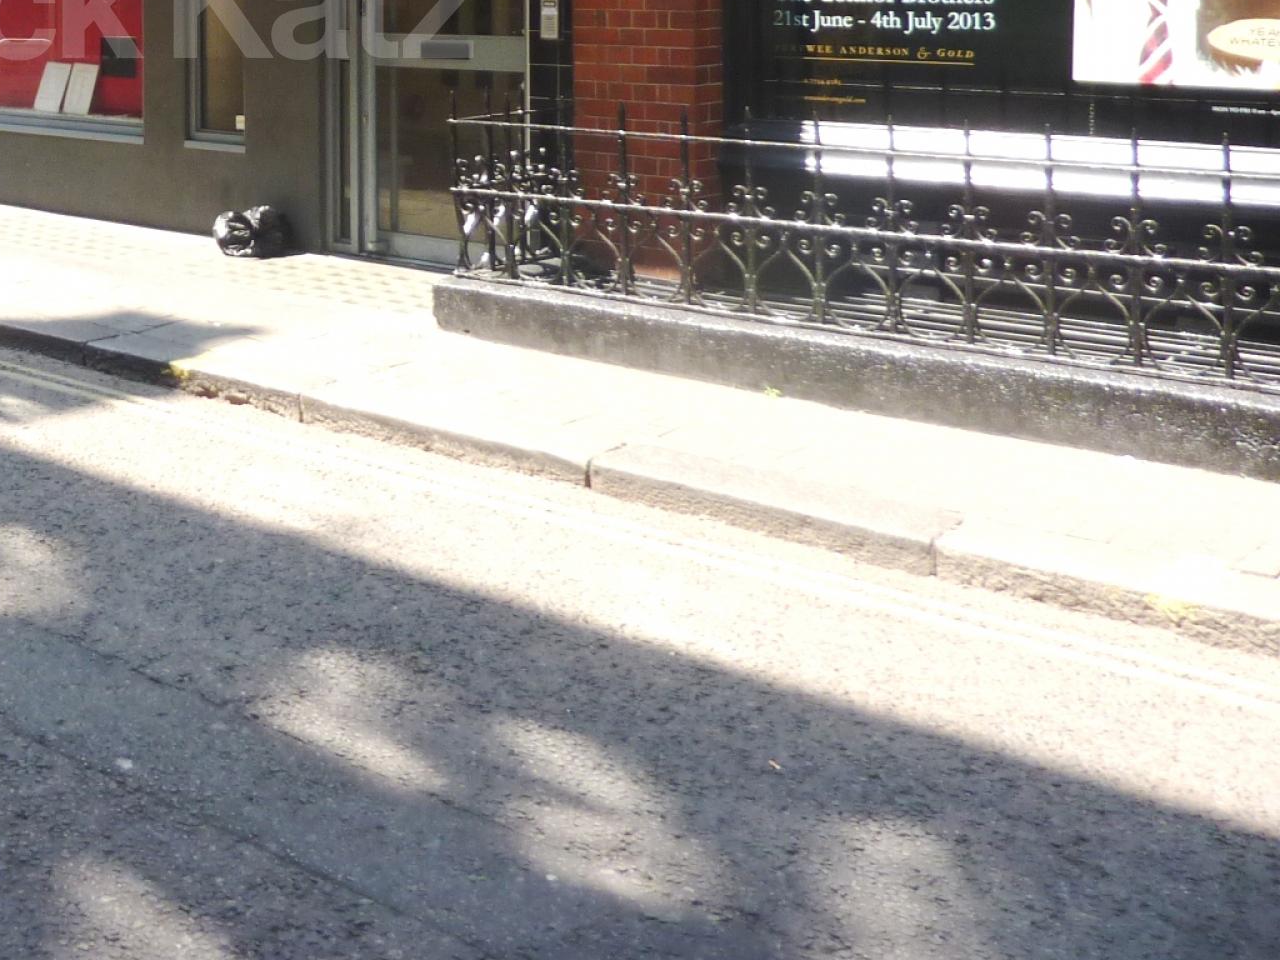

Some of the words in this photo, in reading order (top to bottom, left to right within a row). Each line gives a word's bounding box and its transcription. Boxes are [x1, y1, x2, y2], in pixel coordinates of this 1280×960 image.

[773, 9, 809, 27] 21st
[811, 10, 853, 33] June
[870, 11, 901, 30] 4th
[904, 11, 943, 35] July
[947, 12, 996, 30] 2013
[839, 45, 910, 57] ANDERSON
[916, 46, 932, 60] &
[936, 47, 976, 59] GOLD
